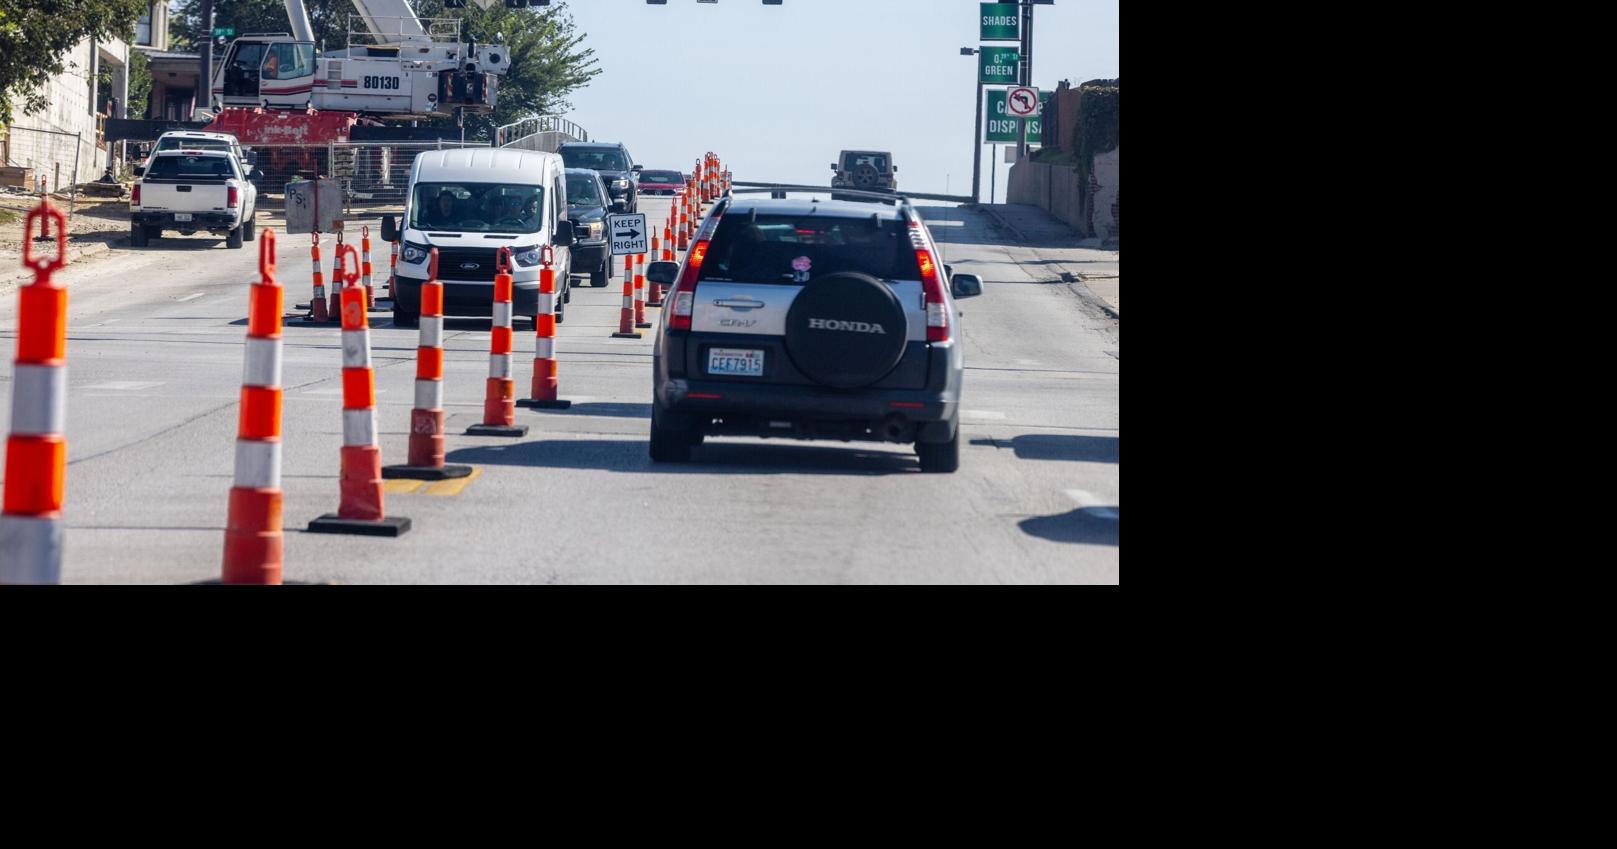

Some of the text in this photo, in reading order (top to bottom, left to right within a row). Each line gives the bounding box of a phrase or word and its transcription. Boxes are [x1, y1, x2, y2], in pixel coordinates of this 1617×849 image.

[982, 15, 1017, 26] SHADES
[984, 65, 1014, 76] GREEN
[363, 75, 400, 90] 80130
[614, 219, 641, 228] KEEP
[613, 240, 644, 250] RIGHT
[808, 318, 887, 334] HONDA
[711, 357, 761, 371] CEF7915
